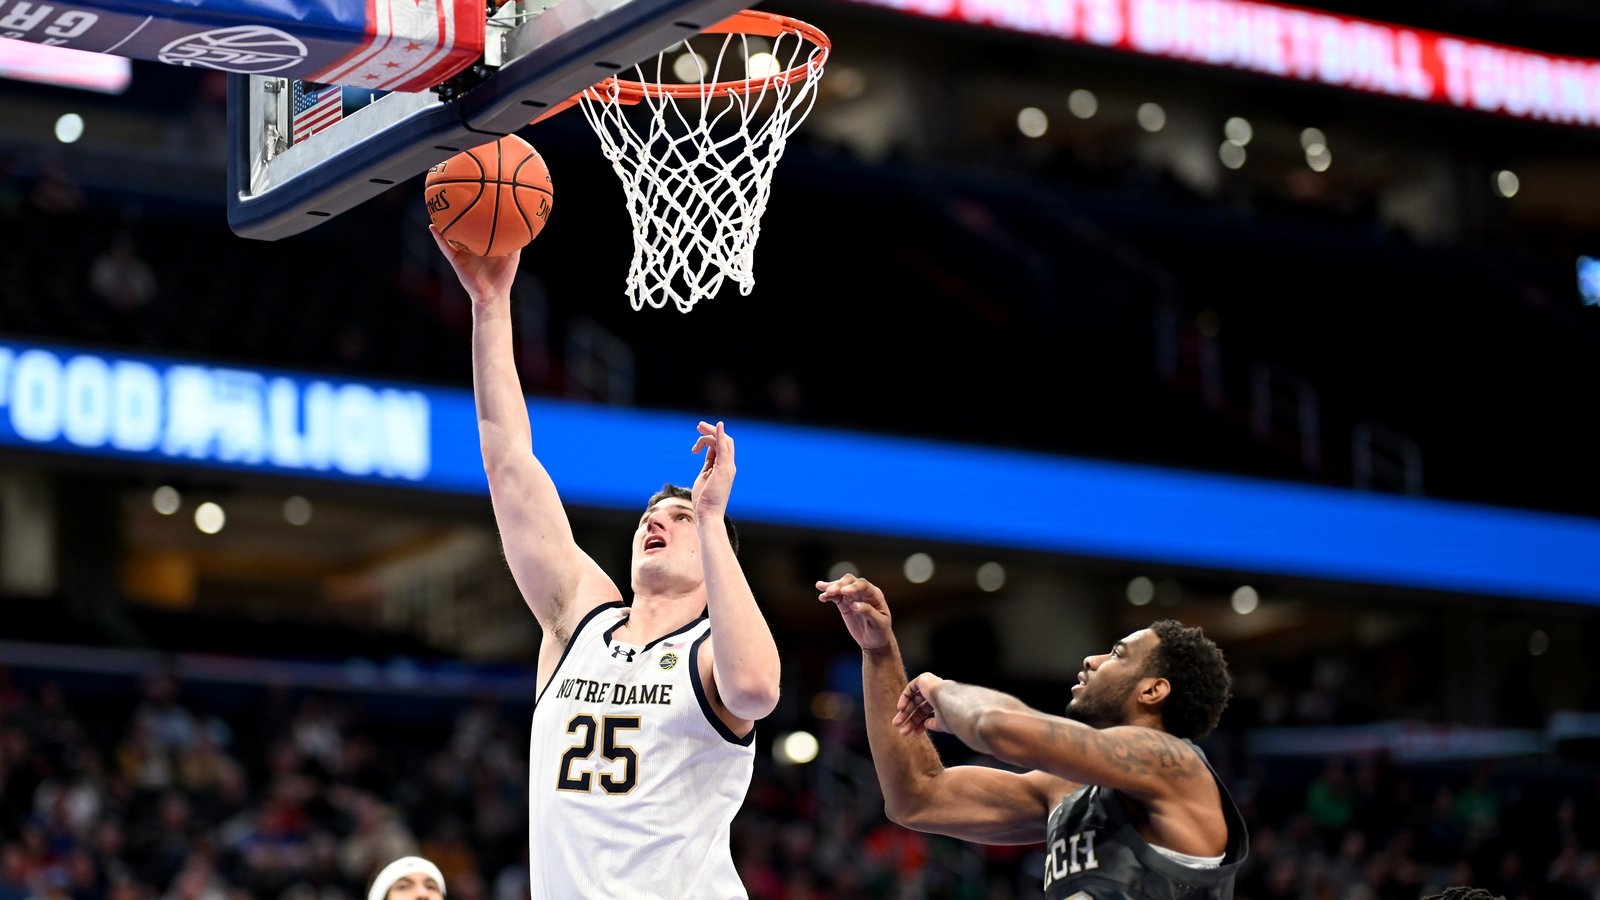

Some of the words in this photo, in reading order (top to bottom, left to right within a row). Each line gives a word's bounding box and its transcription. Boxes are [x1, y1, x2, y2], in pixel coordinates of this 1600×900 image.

[0, 0, 99, 38] GR
[267, 376, 431, 481] LION
[556, 678, 610, 703] NOTRE
[611, 683, 673, 706] DAME
[556, 713, 641, 795] 25
